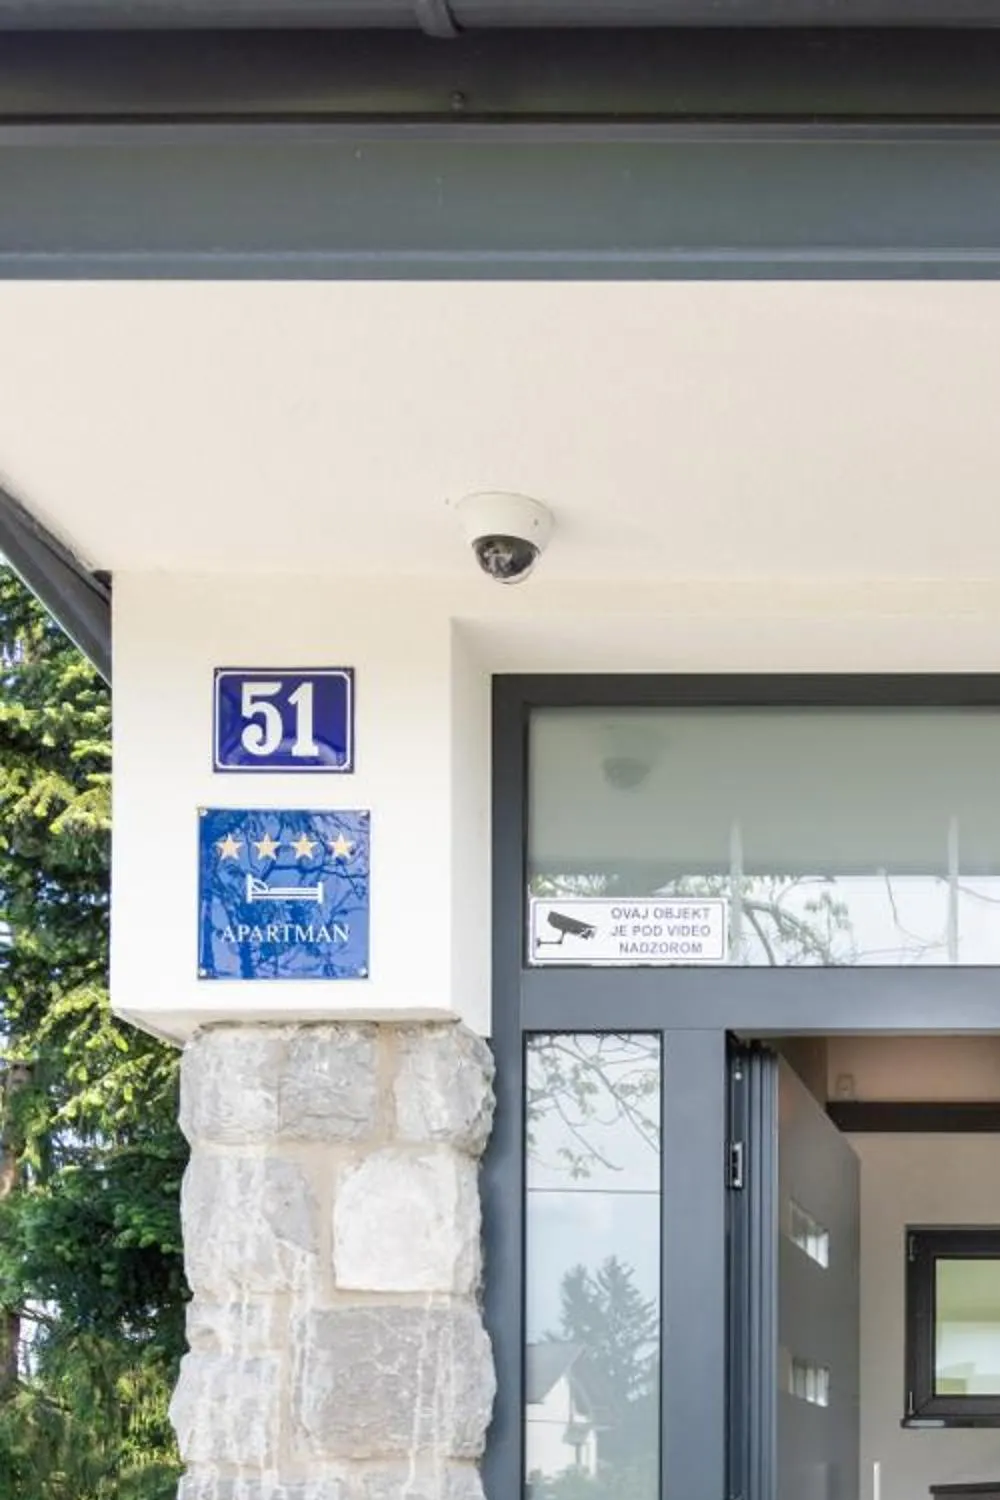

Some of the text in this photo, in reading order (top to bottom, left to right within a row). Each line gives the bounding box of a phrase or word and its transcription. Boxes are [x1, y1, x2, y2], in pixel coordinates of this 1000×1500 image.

[240, 681, 320, 757] 51
[610, 906, 710, 920] OVAJ OBJEKT
[220, 924, 350, 944] APARTMAN
[610, 924, 711, 937] JE POD VIDEO
[619, 941, 703, 955] NADZOROM
